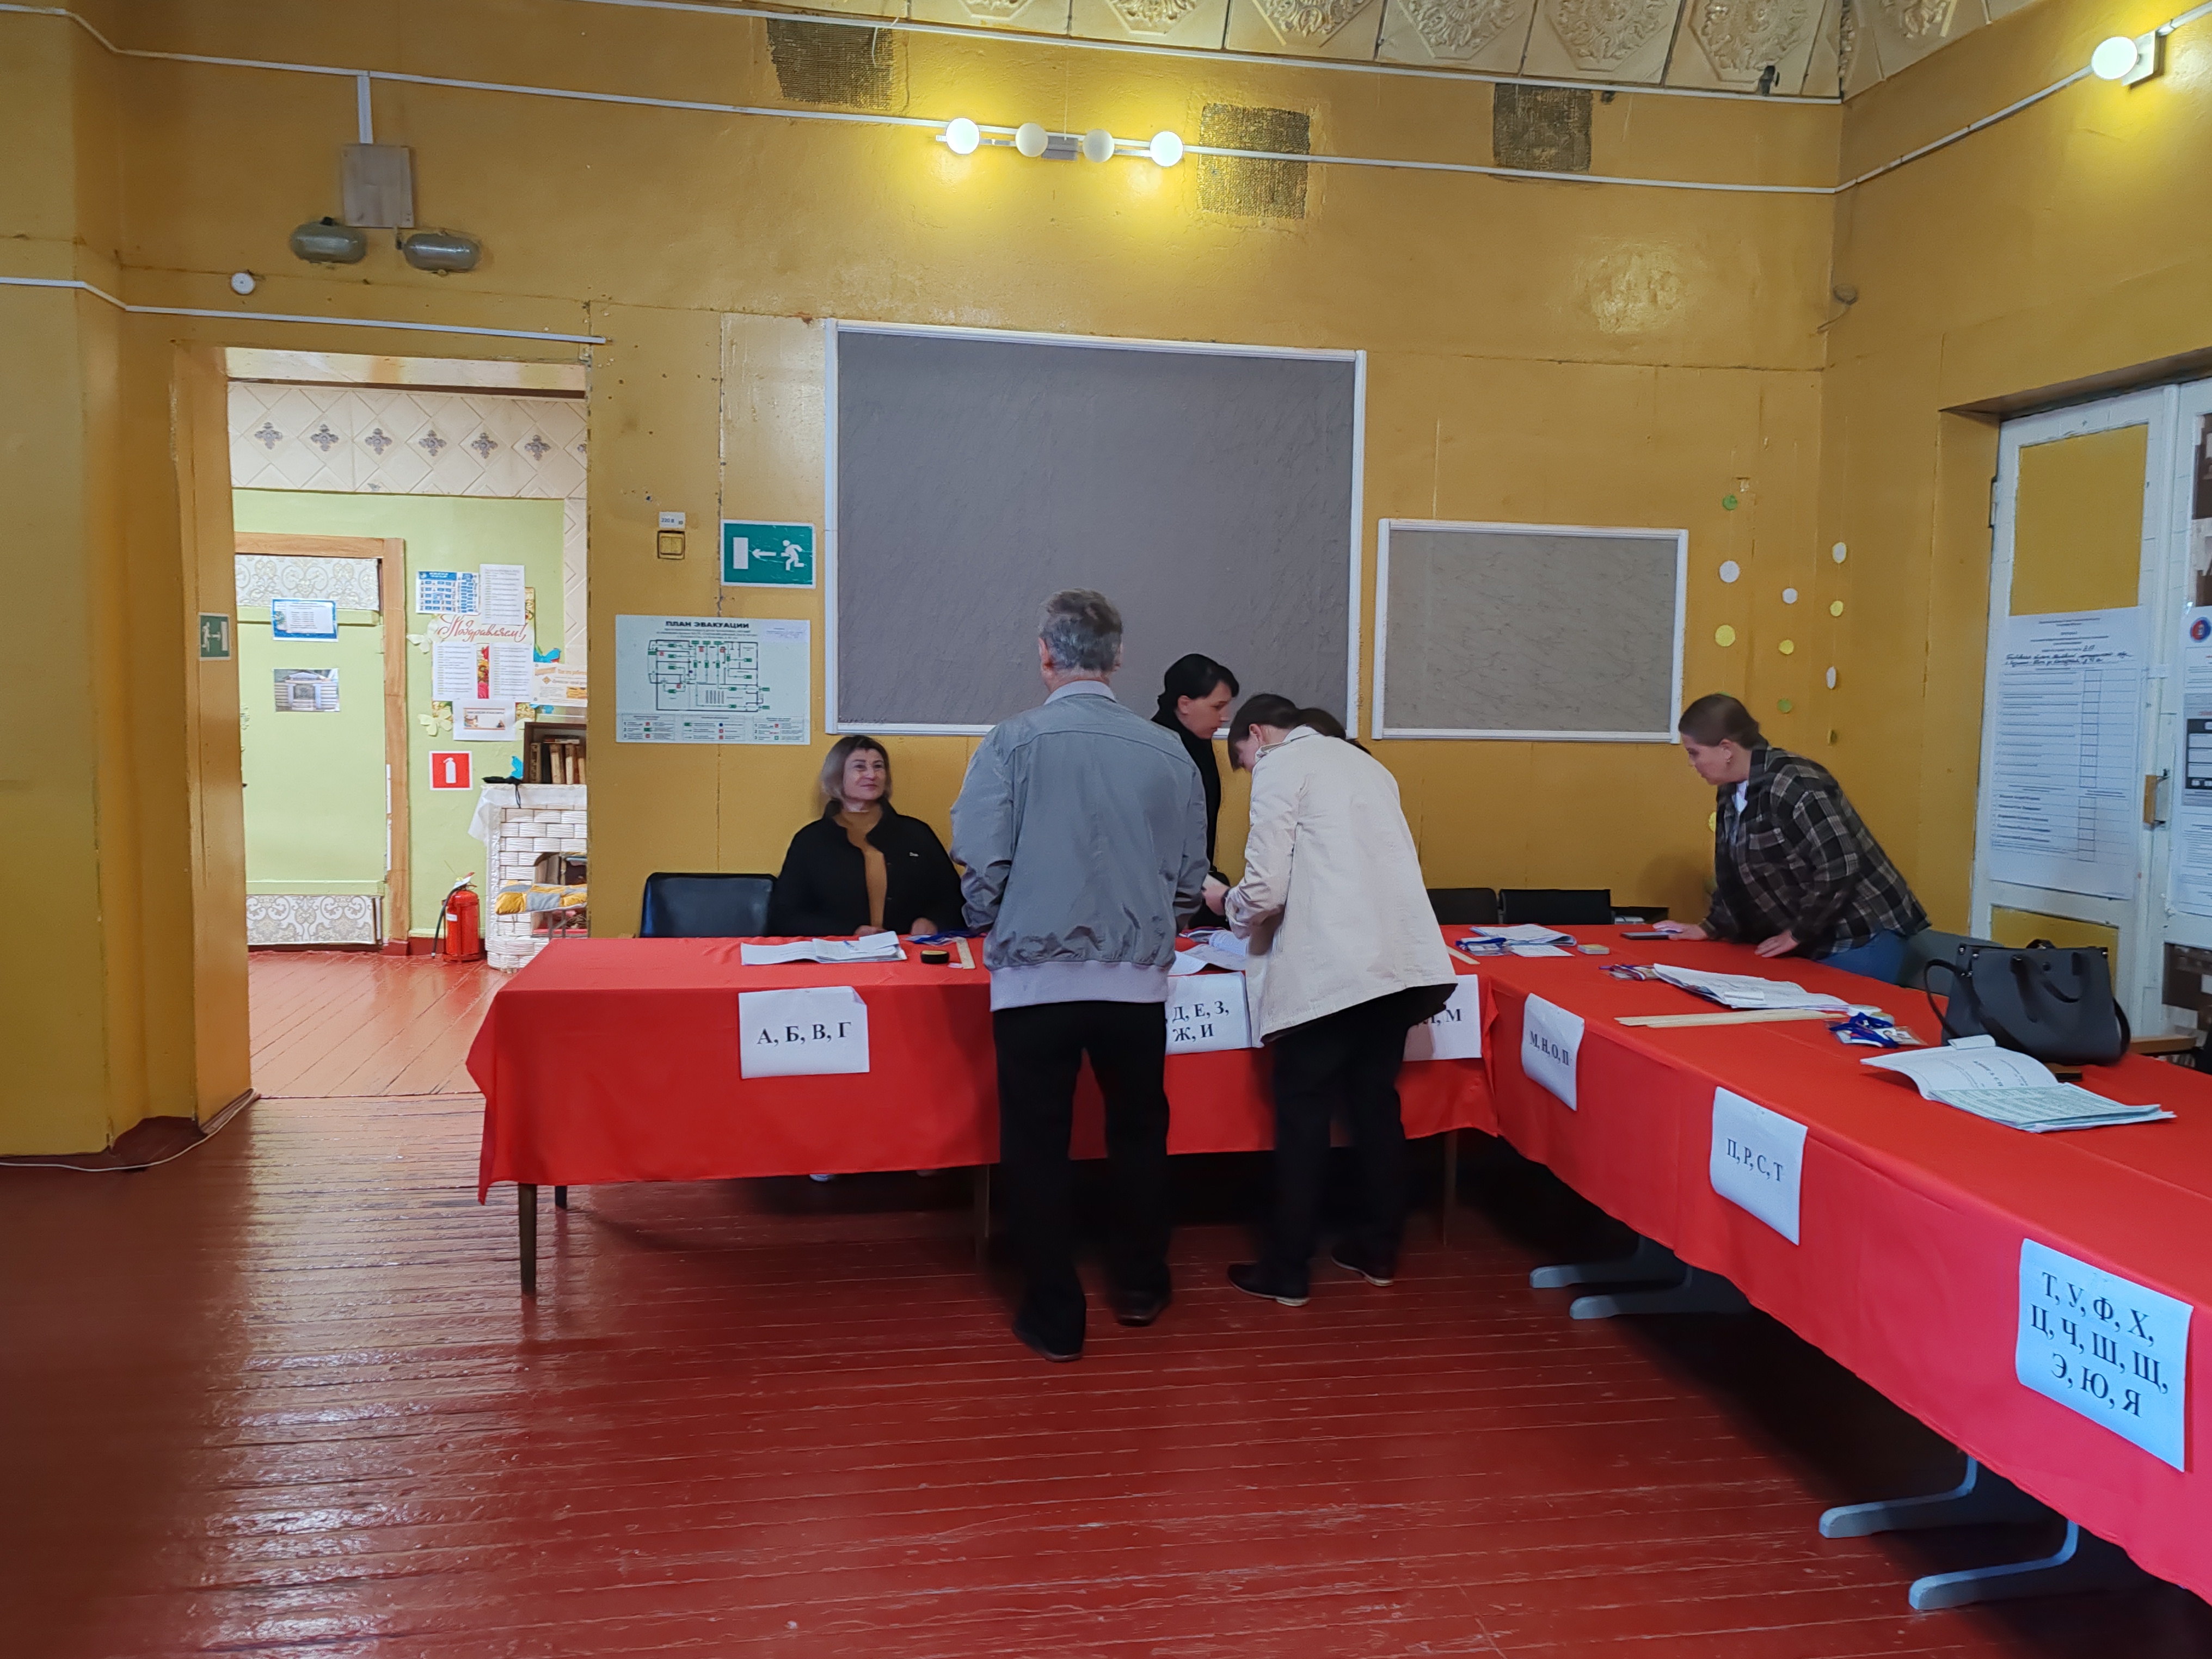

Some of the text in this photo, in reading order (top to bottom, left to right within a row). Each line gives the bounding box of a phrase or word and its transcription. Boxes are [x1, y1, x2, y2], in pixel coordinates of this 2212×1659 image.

[437, 614, 527, 642] Поздравляем!
[1172, 1001, 1229, 1024] Д, Е, З,
[1446, 1009, 1462, 1023] М
[757, 1022, 852, 1047] А, Б, В, Г
[1172, 1023, 1214, 1042] Ж, И
[1552, 1044, 1560, 1064] О,
[1562, 1049, 1570, 1066] П
[1727, 1138, 1783, 1182] П, Р, С, Т
[2042, 1271, 2155, 1347] Т, У, Ф, Х,
[2030, 1304, 2169, 1394] Ц, Ч, Ш, Щ,
[2051, 1353, 2142, 1418] Э, Ю, Я
